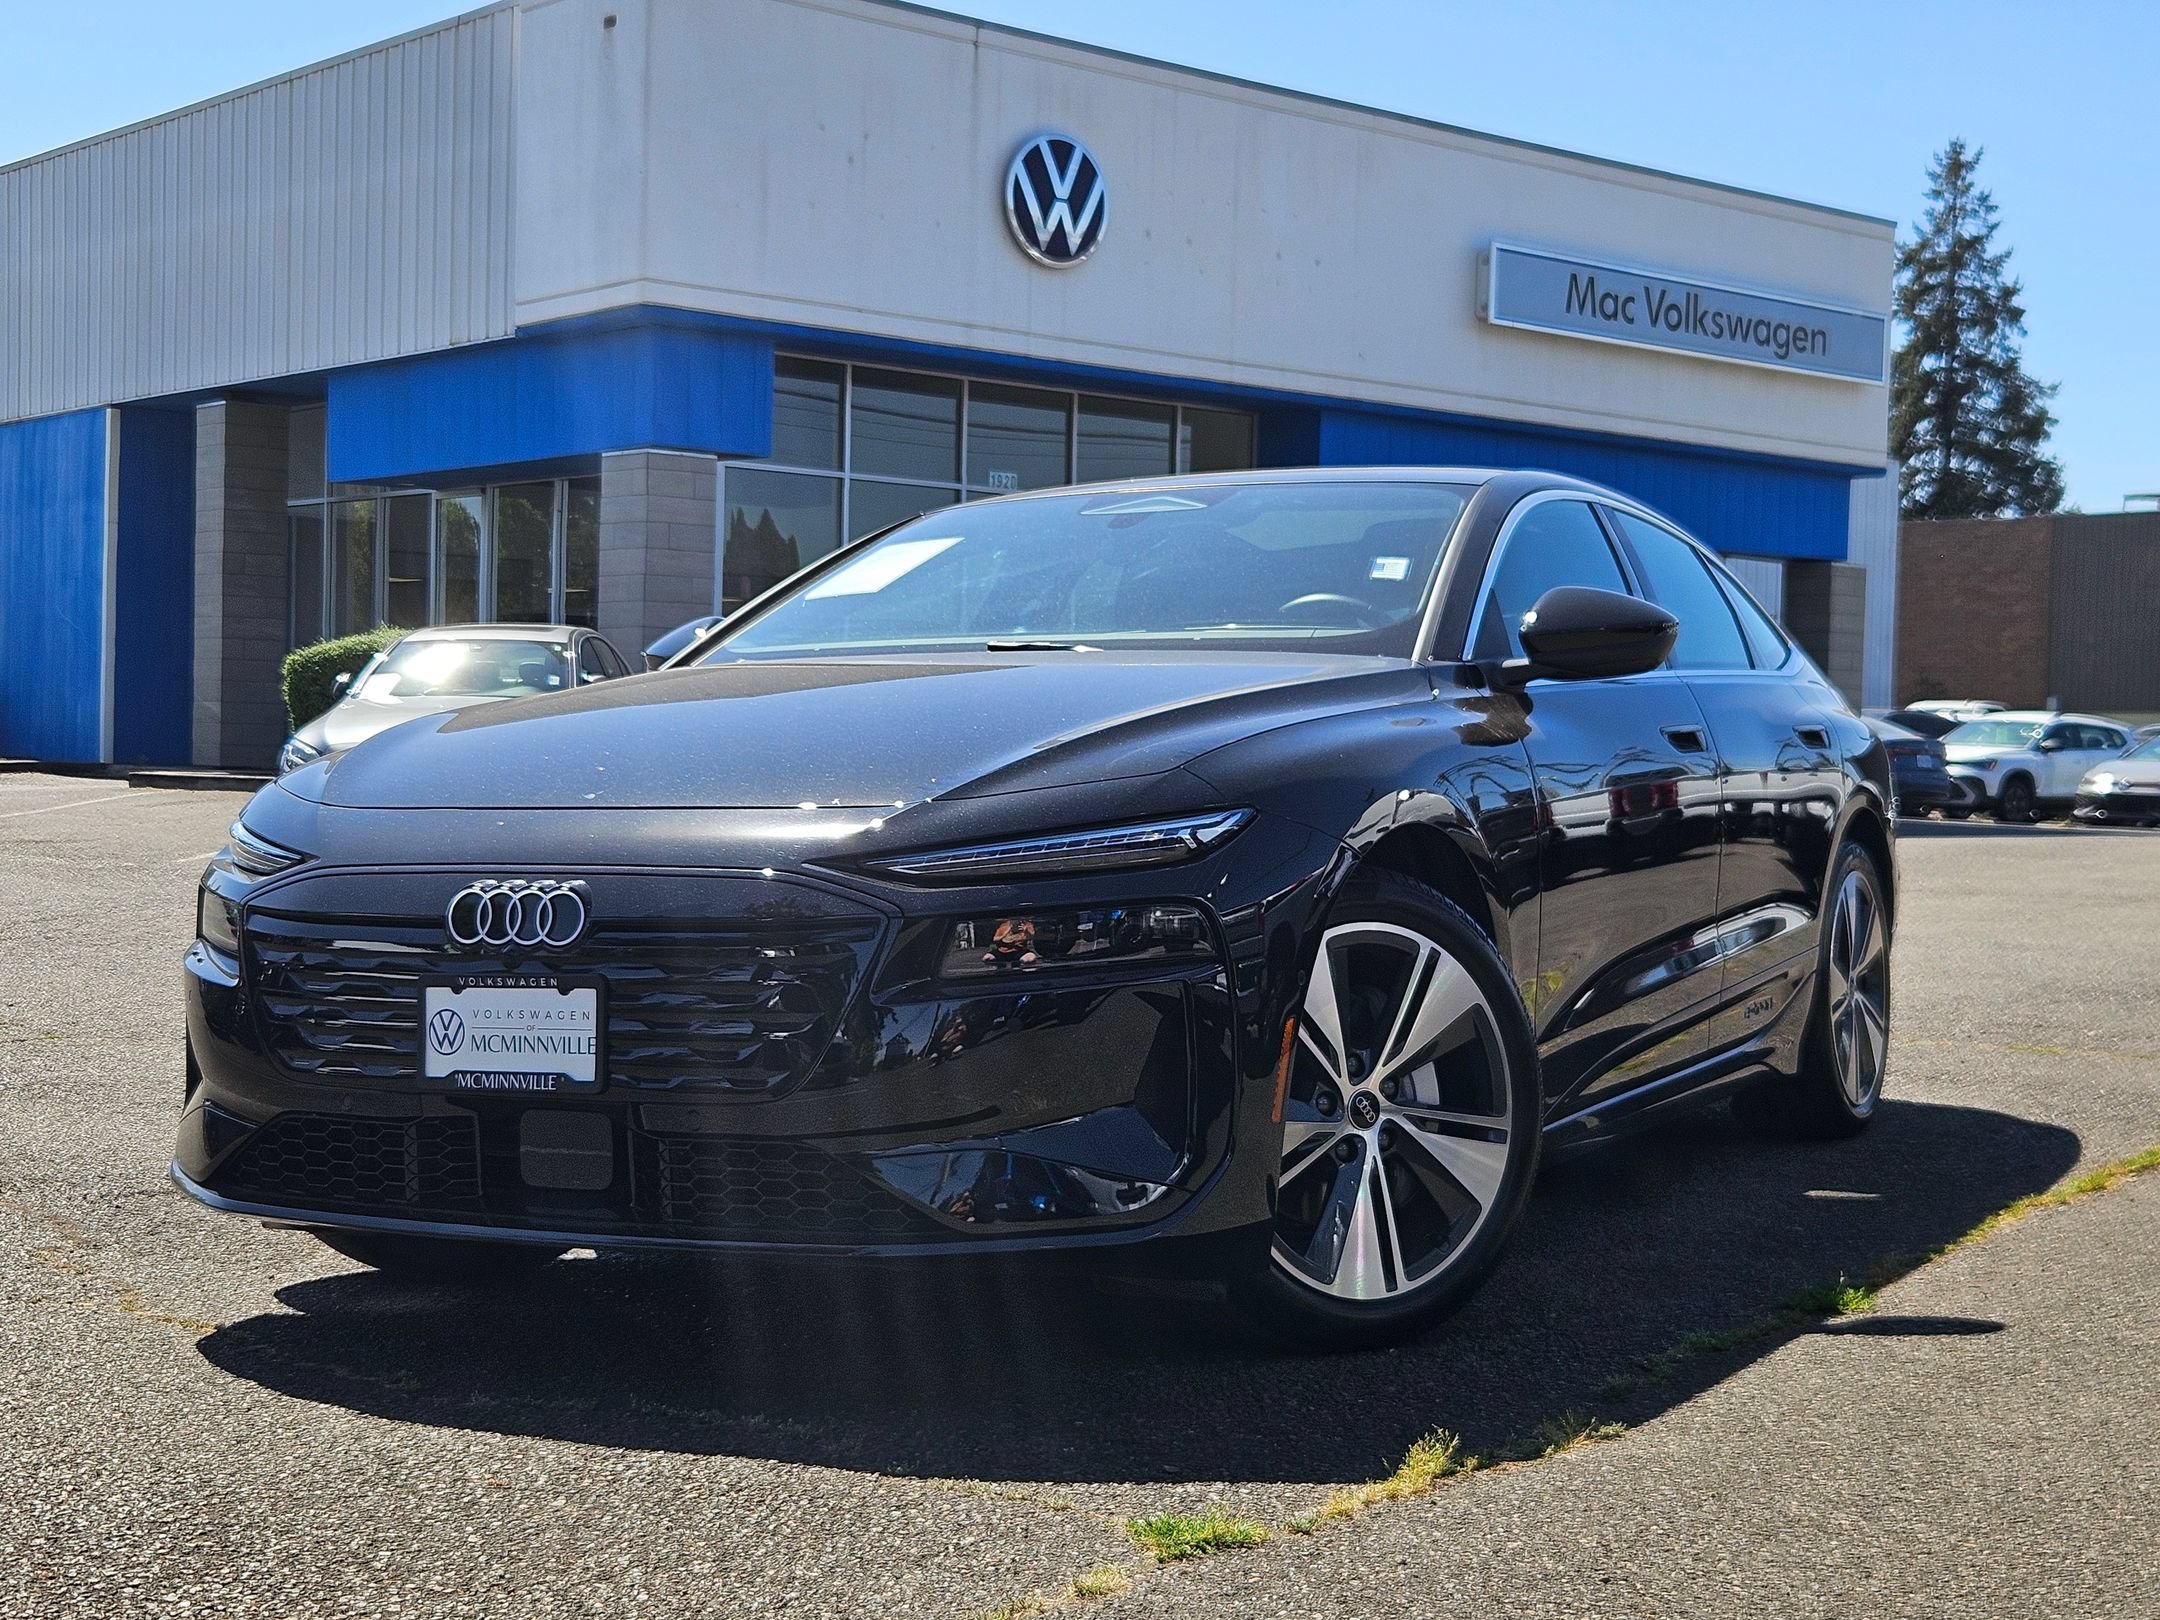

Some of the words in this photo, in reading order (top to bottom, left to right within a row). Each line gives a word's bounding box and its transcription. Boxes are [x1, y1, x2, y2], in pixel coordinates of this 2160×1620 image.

[1565, 272, 1635, 326] Mac
[1643, 285, 1828, 361] Volkswagen
[459, 976, 558, 986] VOLKSWAGEN
[472, 1009, 591, 1020] VOLKSWAGEN
[526, 1024, 536, 1032] OF
[470, 1034, 597, 1055] MCMINNVILLE
[456, 1073, 557, 1091] MCMINNVILLE
